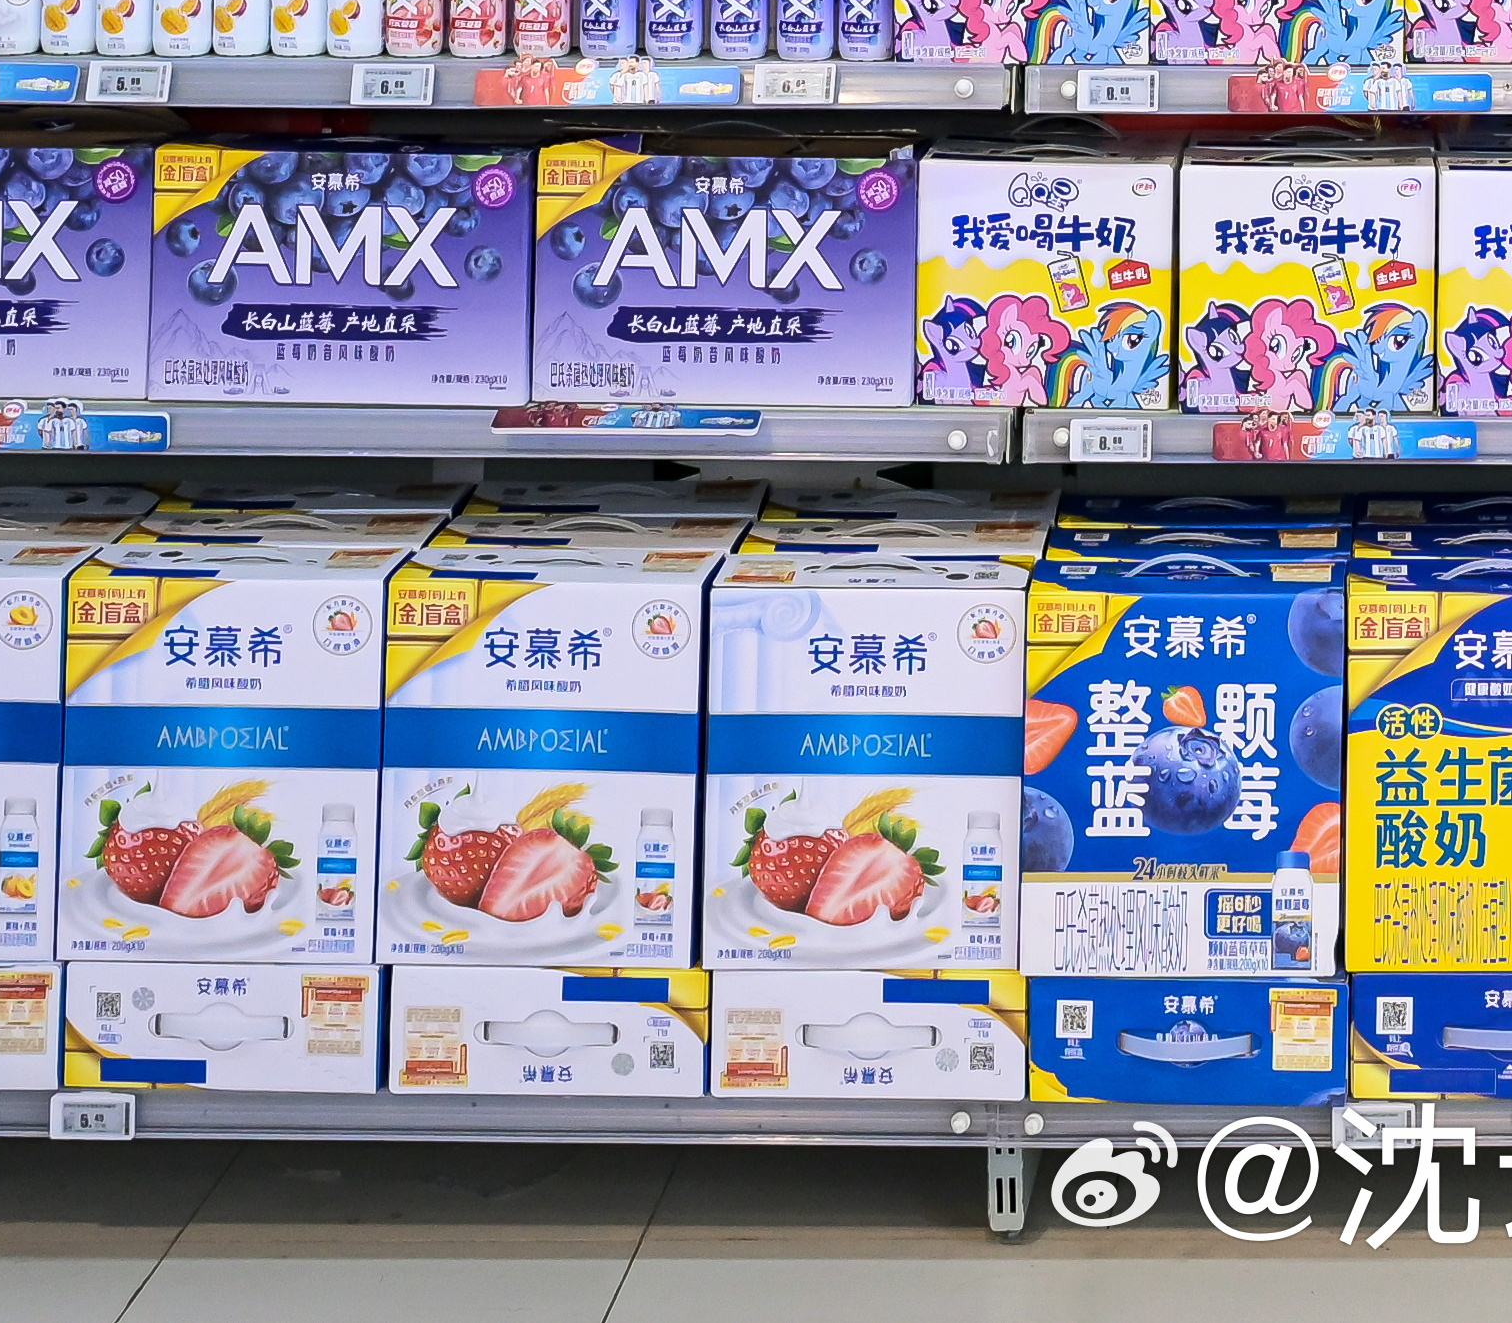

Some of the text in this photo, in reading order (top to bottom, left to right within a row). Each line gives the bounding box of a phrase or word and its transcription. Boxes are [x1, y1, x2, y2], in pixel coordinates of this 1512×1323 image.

[212, 205, 463, 287] AMX
[952, 215, 1136, 258] 我爱喝牛奶
[484, 628, 603, 670] 安慕希
[1123, 615, 1247, 659] 安慕希
[1382, 710, 1437, 736] 活性
[1376, 810, 1486, 869] 酸奶
